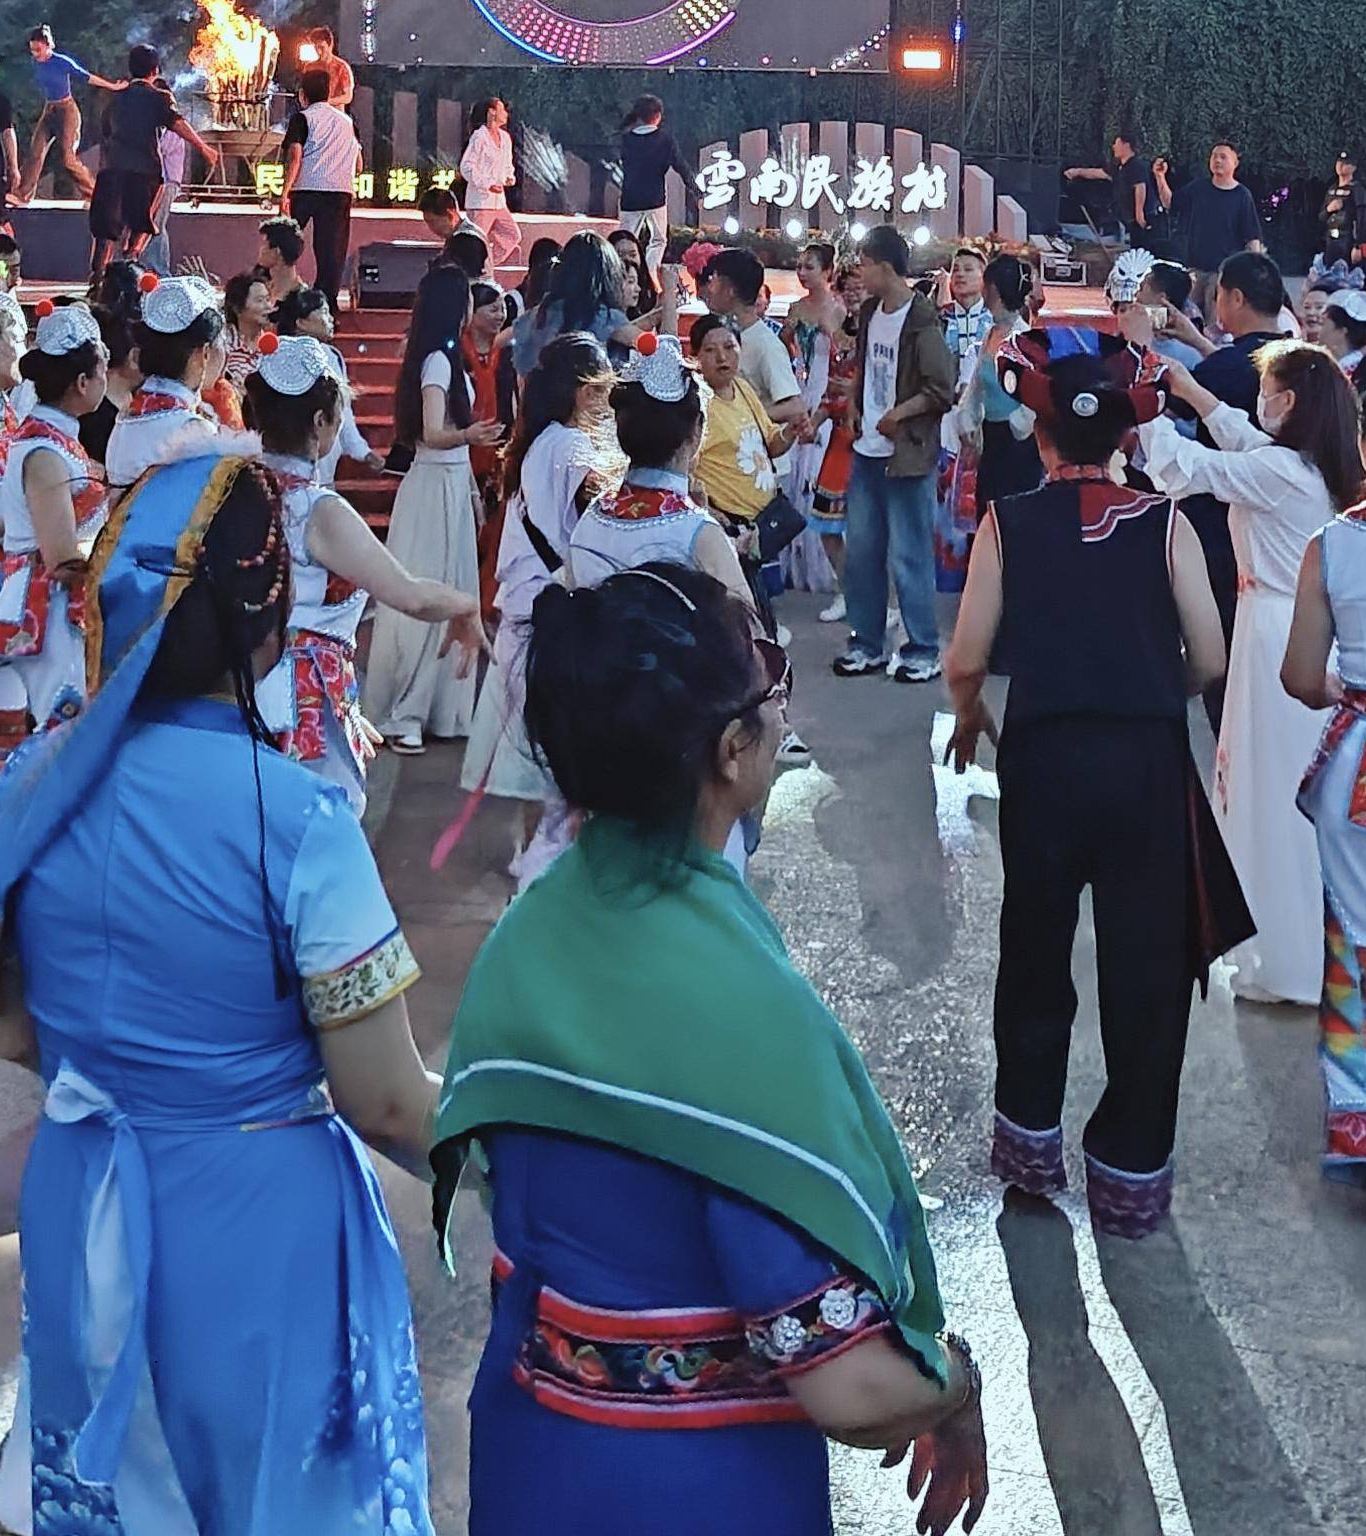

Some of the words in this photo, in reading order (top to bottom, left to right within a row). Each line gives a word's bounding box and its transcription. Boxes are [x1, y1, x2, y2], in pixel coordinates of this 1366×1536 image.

[695, 150, 949, 214] 雲南民族村
